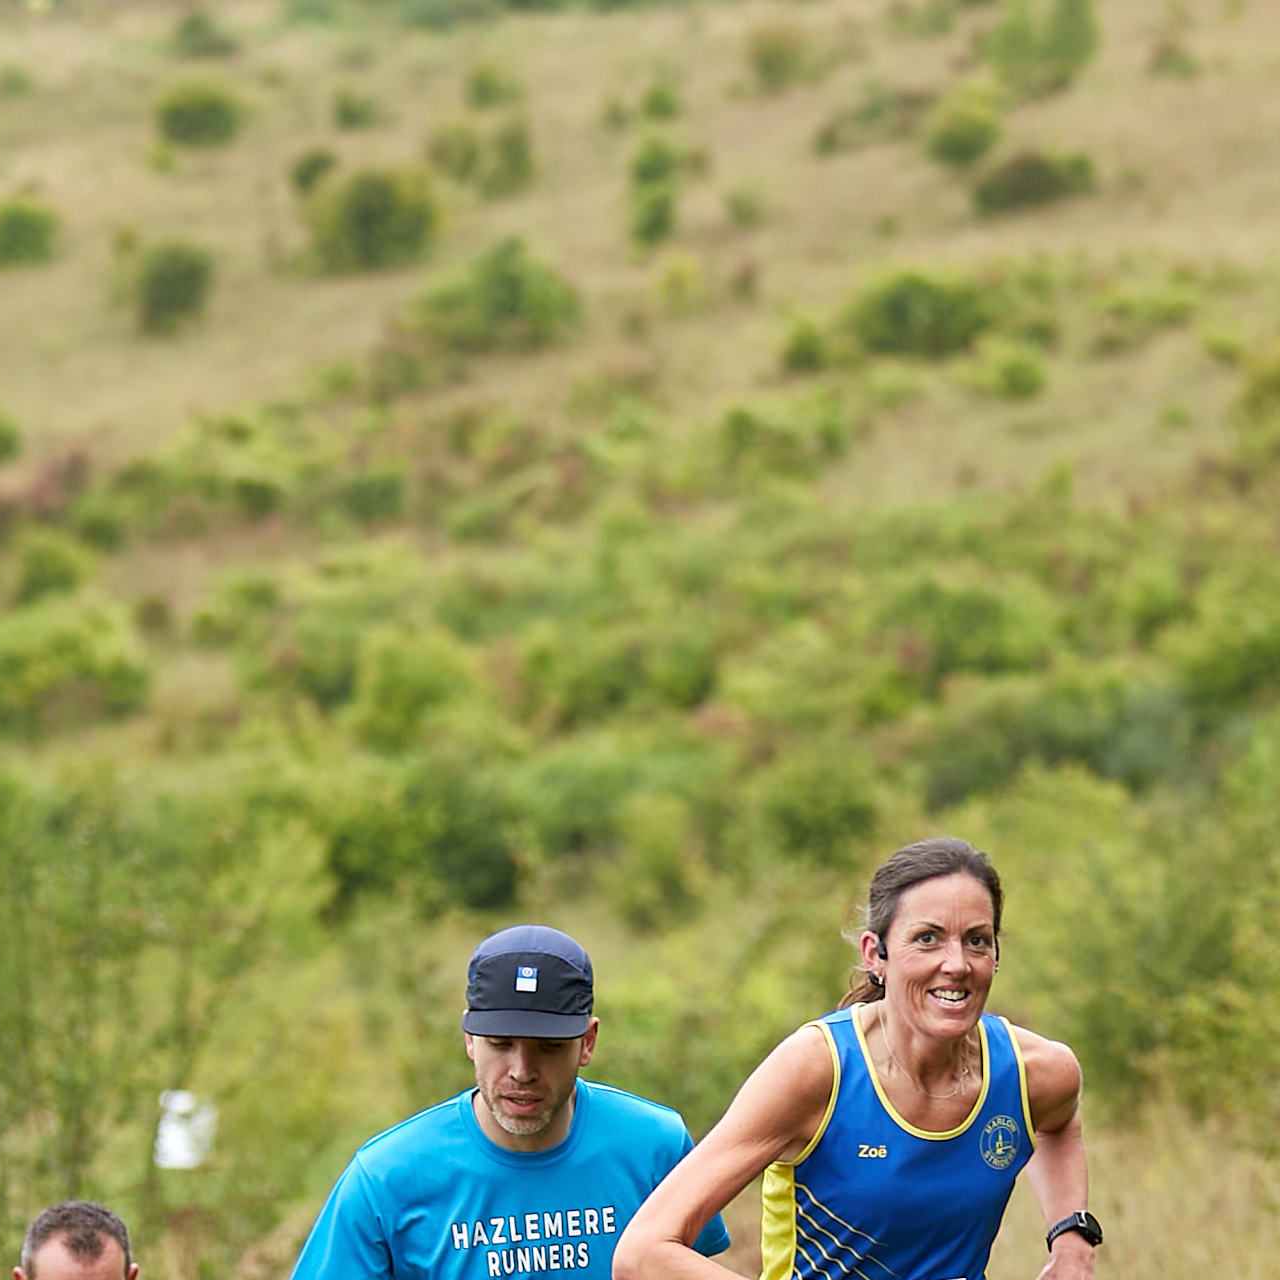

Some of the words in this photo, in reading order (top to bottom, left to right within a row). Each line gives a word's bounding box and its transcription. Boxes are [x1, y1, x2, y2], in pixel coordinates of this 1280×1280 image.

[858, 1144, 887, 1158] Zoë
[451, 1206, 616, 1250] HAZLEMERE
[487, 1242, 590, 1278] RUNNERS
